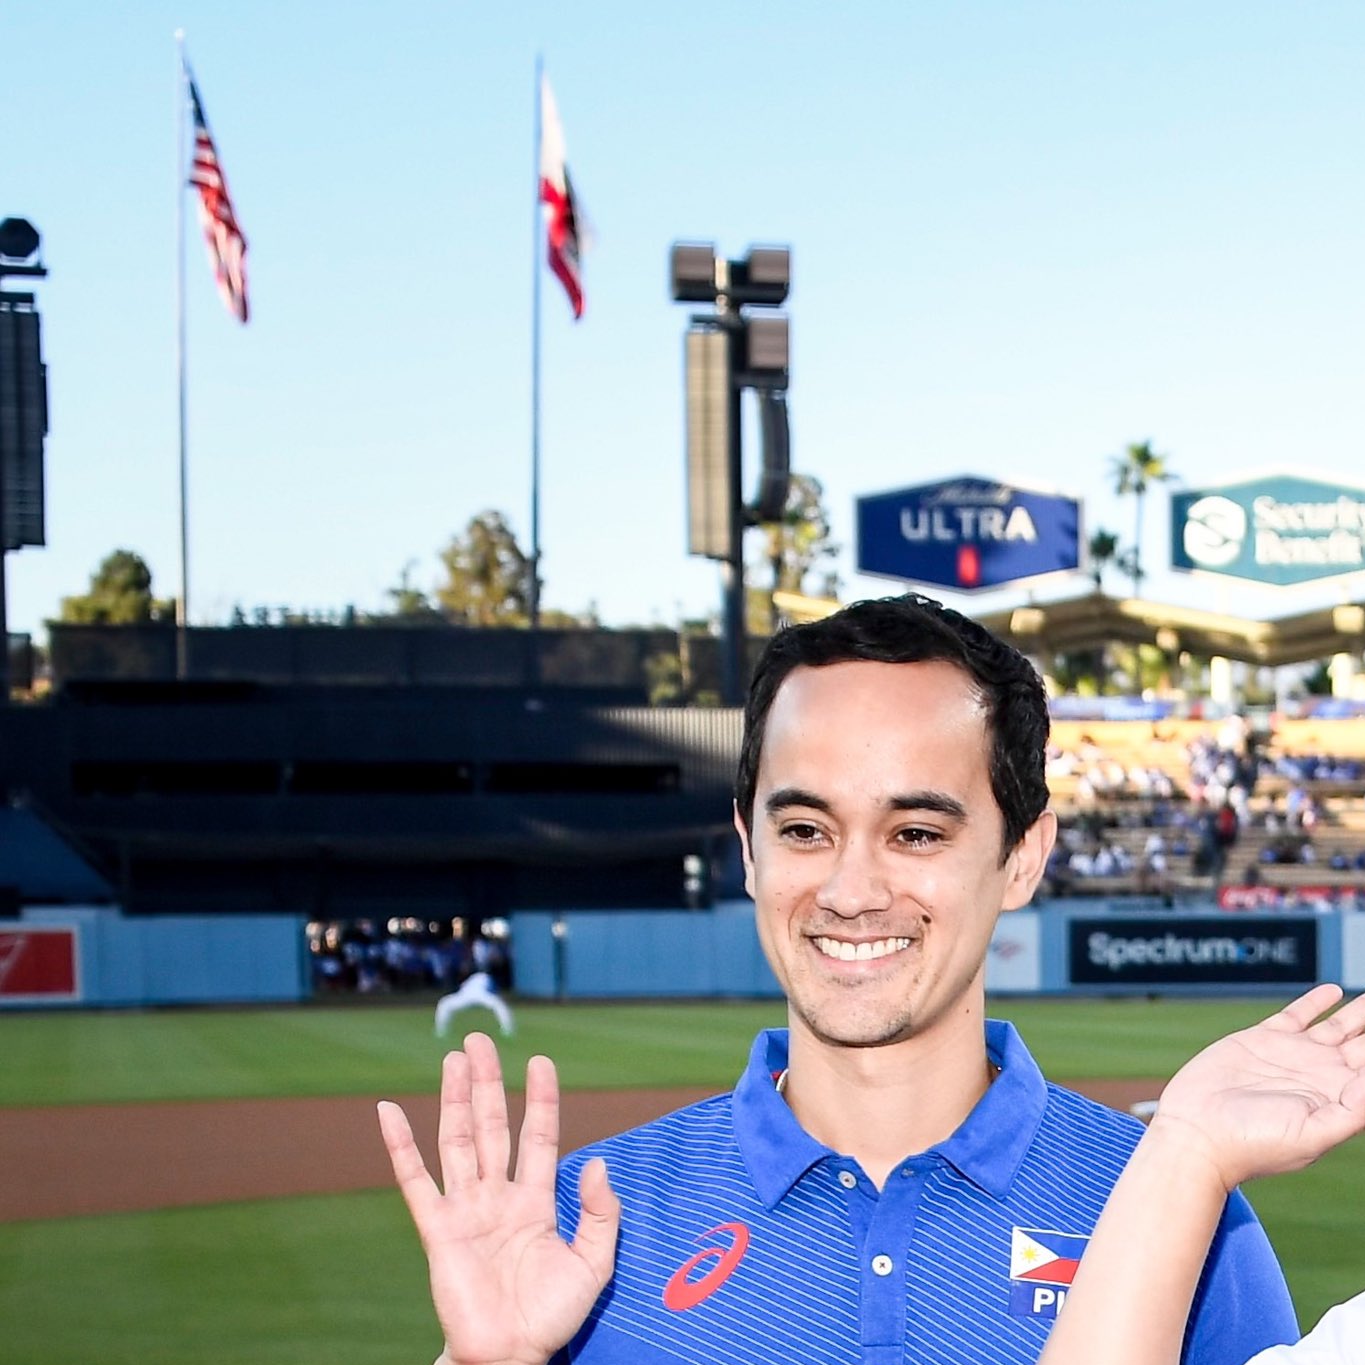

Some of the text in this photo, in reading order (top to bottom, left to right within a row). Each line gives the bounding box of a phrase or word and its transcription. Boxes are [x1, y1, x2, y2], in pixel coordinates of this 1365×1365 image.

[901, 505, 1039, 543] ULTRA
[1255, 529, 1363, 565] Benefit
[1087, 931, 1237, 972] Spectrum
